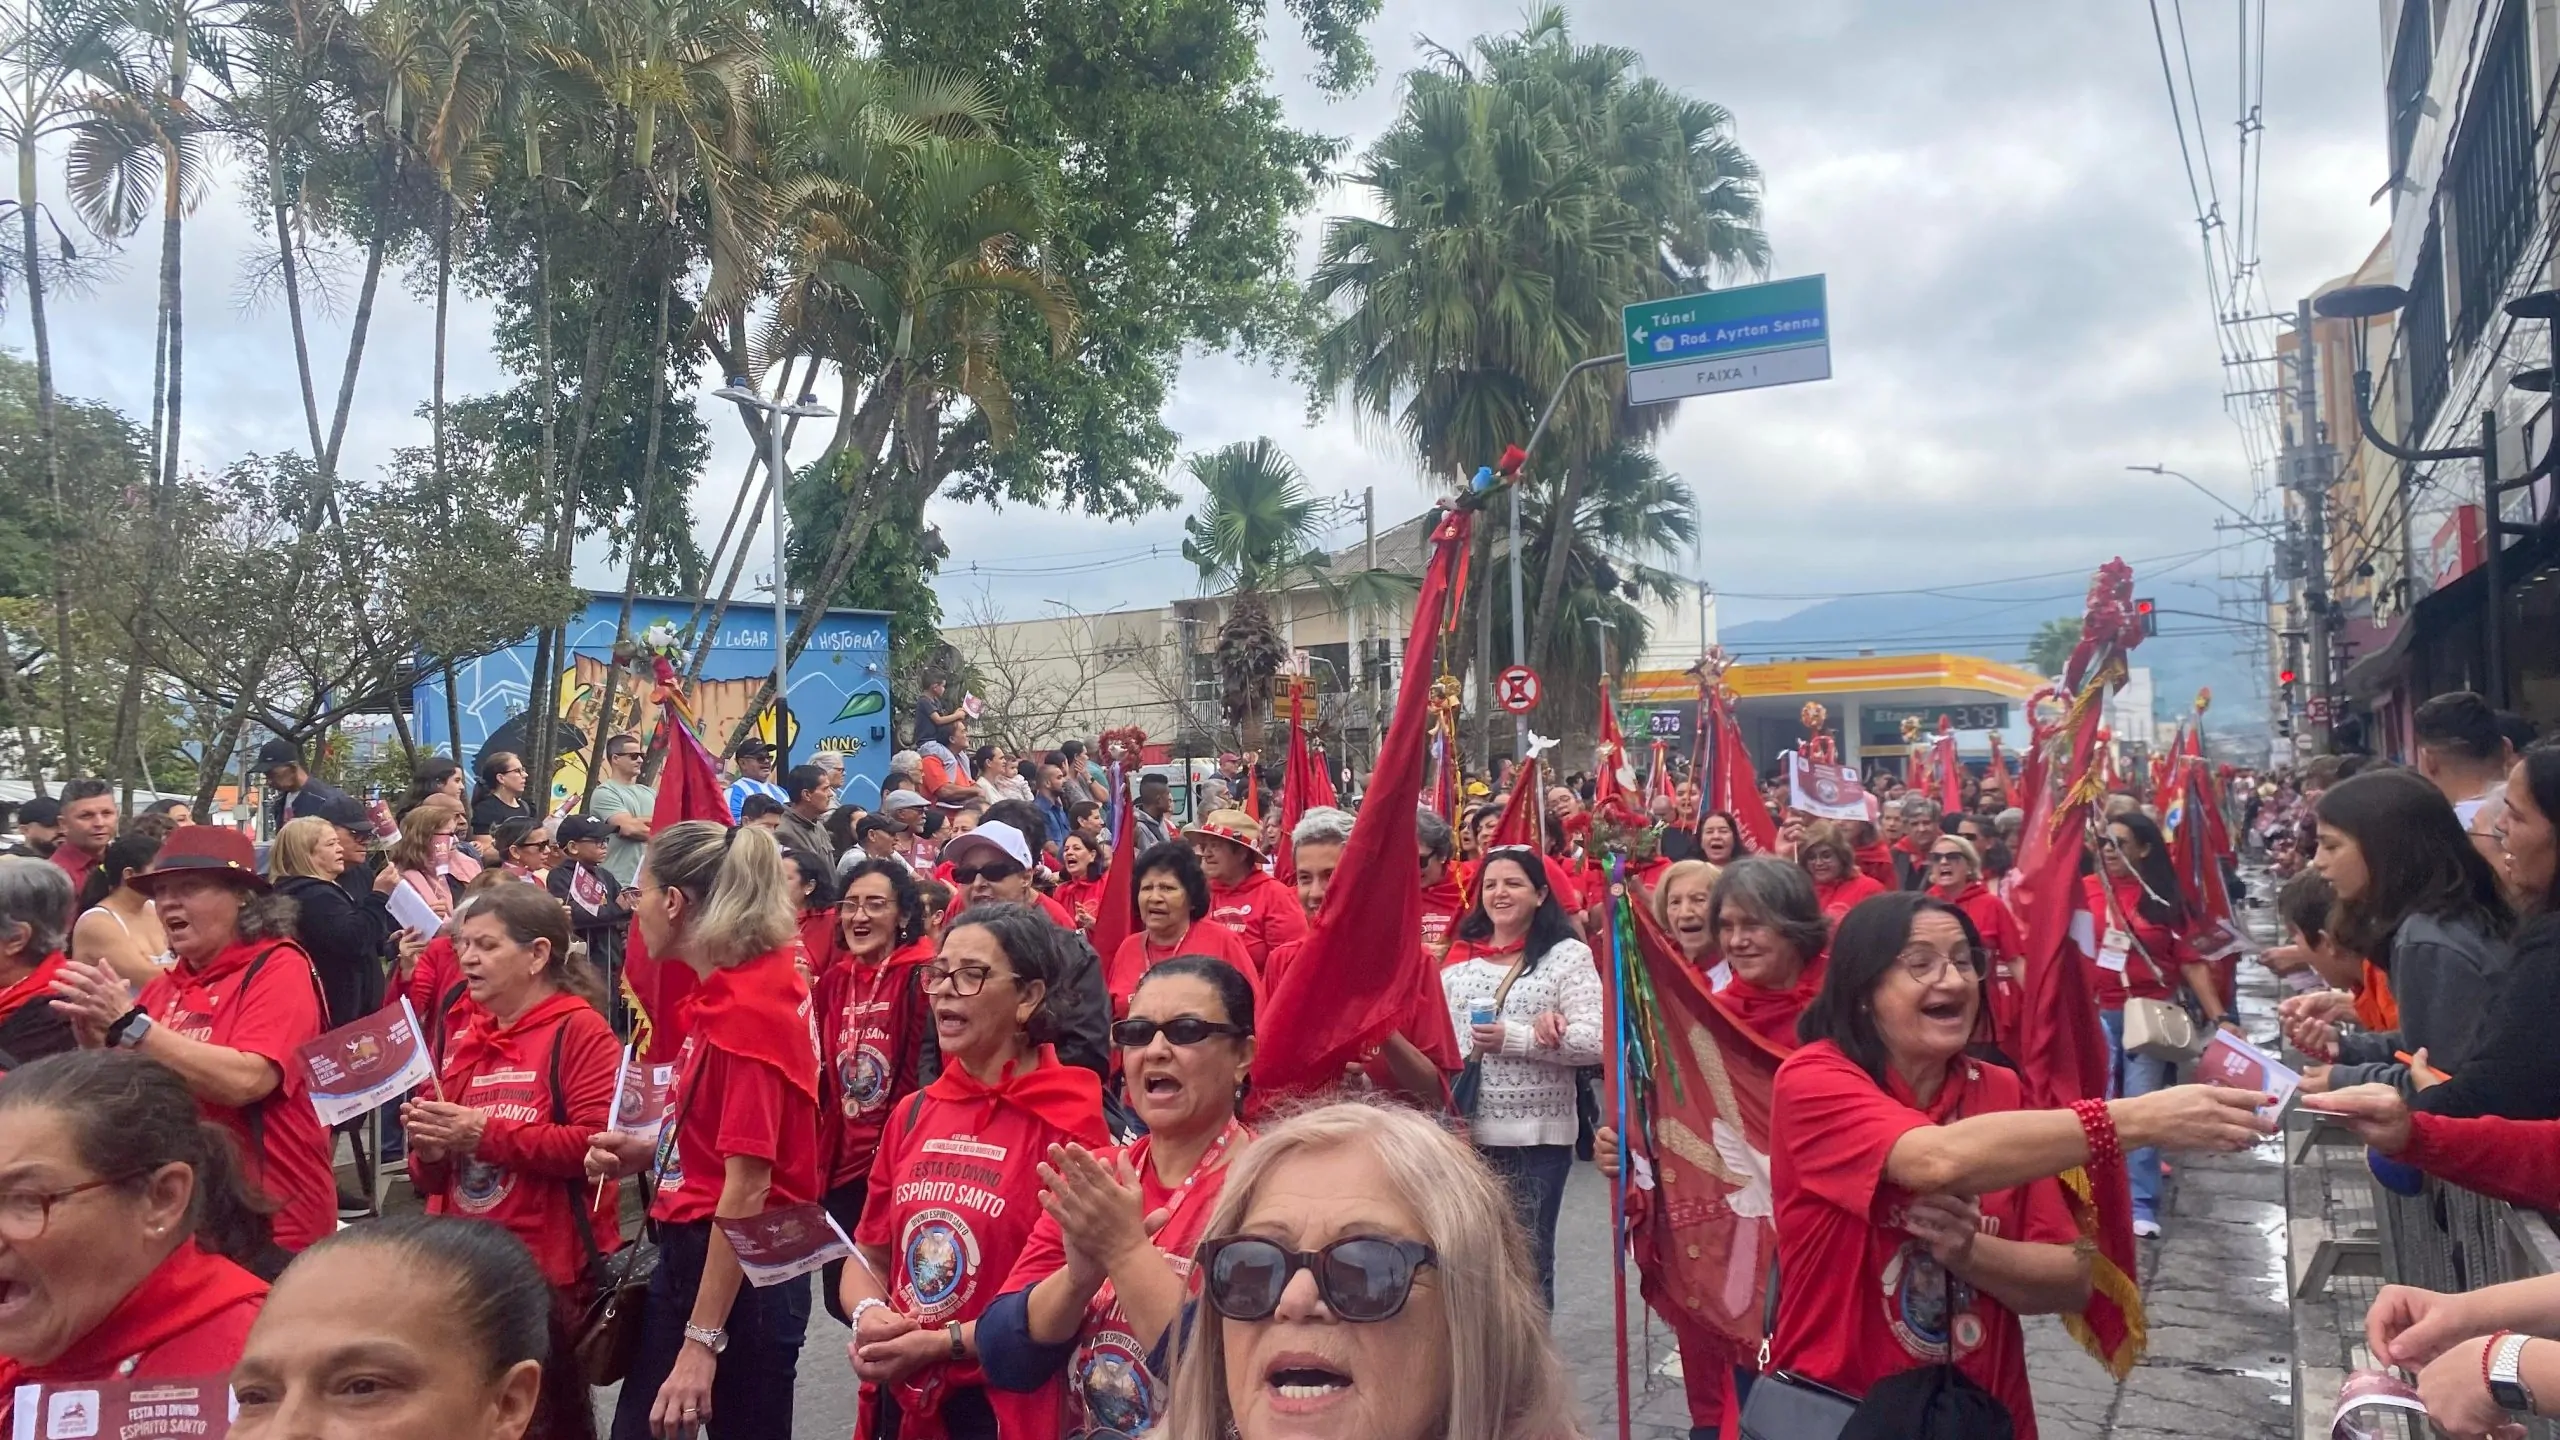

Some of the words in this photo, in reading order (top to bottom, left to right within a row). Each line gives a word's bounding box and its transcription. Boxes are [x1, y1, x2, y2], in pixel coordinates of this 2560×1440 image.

[1651, 310, 1696, 327] Túnel
[1680, 332, 1710, 346] Rod.
[1716, 324, 1768, 342] Ayrton
[1773, 316, 1820, 333] Senna
[1696, 368, 1743, 384] FAIXA
[1652, 716, 1680, 733] 3,79
[495, 1103, 538, 1123] SANTO
[910, 1161, 941, 1178] FESTA
[962, 1164, 1002, 1188] DIVINO
[896, 1178, 956, 1206] ESPÍRITO
[955, 1184, 1006, 1218] SANTO
[952, 1217, 970, 1236] SANTO
[128, 1406, 153, 1422] FESTA
[169, 1404, 198, 1416] DIVINO
[120, 1418, 168, 1440] ESPÍRITO
[169, 1418, 207, 1434] SANTO
